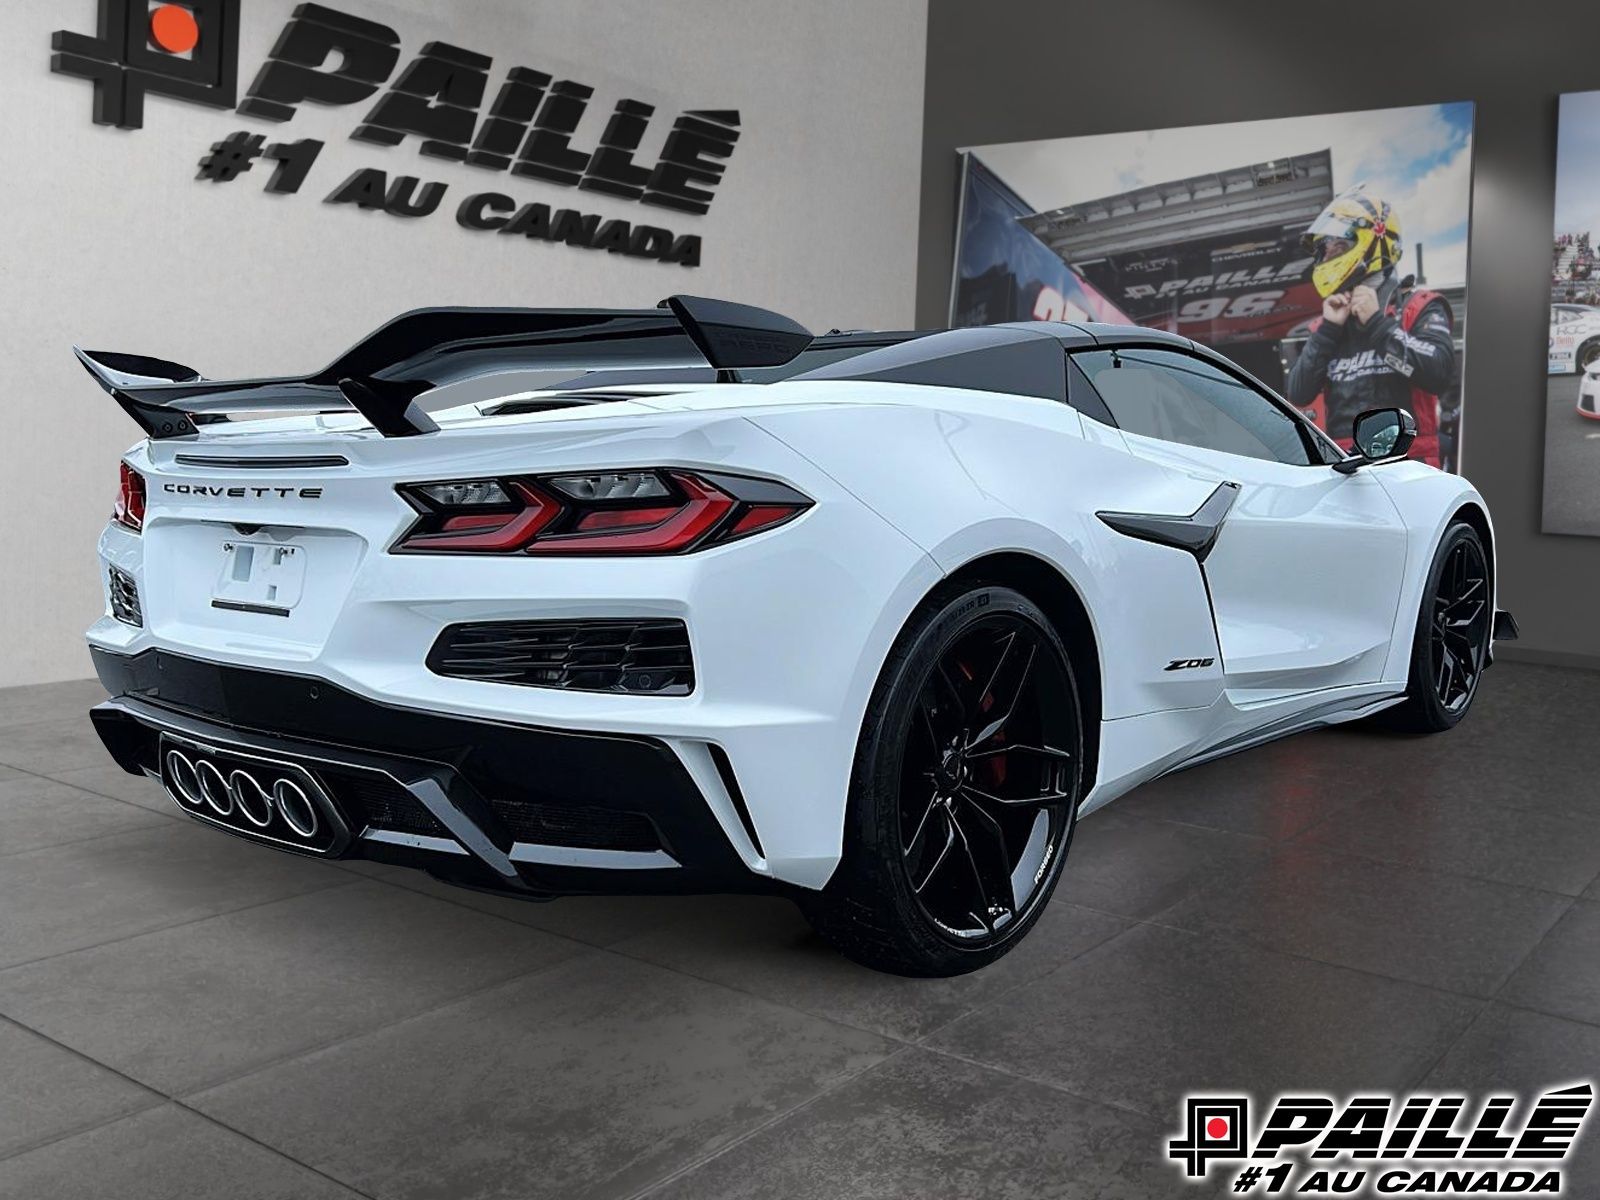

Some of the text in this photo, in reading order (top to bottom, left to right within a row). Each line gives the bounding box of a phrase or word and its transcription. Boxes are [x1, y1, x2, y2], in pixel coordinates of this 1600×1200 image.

[236, 2, 741, 216] PAILLÉ
[195, 130, 703, 268] #1 AU CANADA
[1176, 290, 1285, 323] 96
[163, 483, 323, 499] CORVETTE
[1163, 657, 1215, 671] Z06
